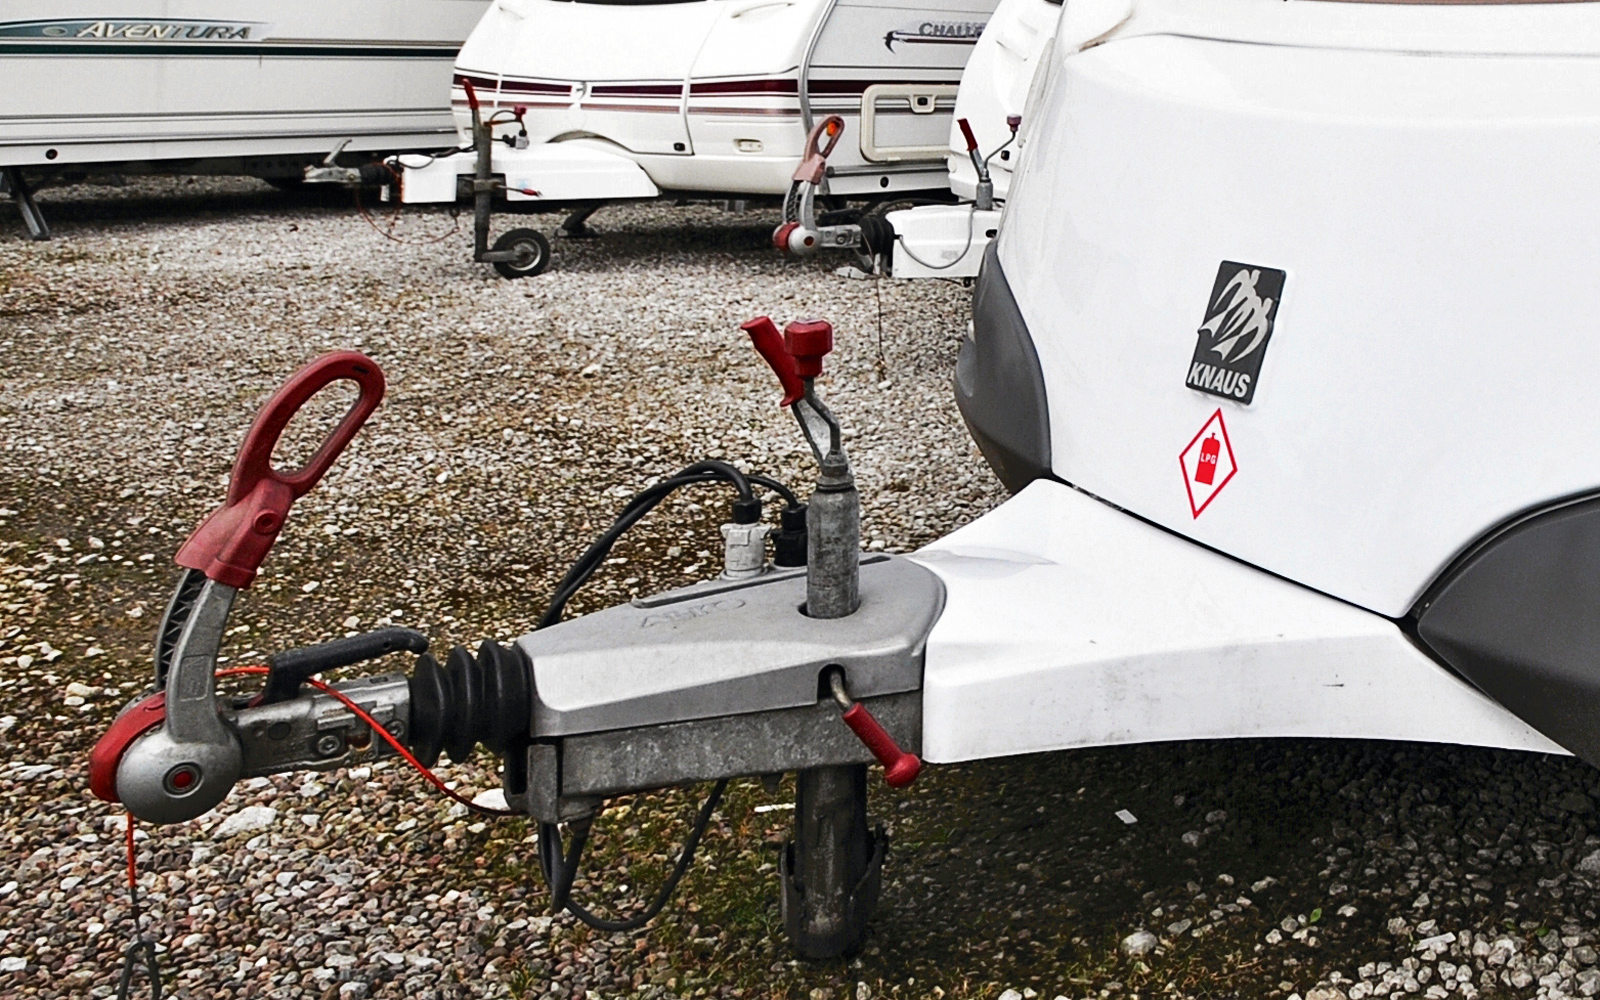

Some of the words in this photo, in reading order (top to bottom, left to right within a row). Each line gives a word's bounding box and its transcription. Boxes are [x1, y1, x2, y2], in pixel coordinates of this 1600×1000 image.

[76, 20, 250, 39] AVENTURA
[1187, 361, 1251, 398] KNAUS
[1200, 452, 1217, 465] LPG
